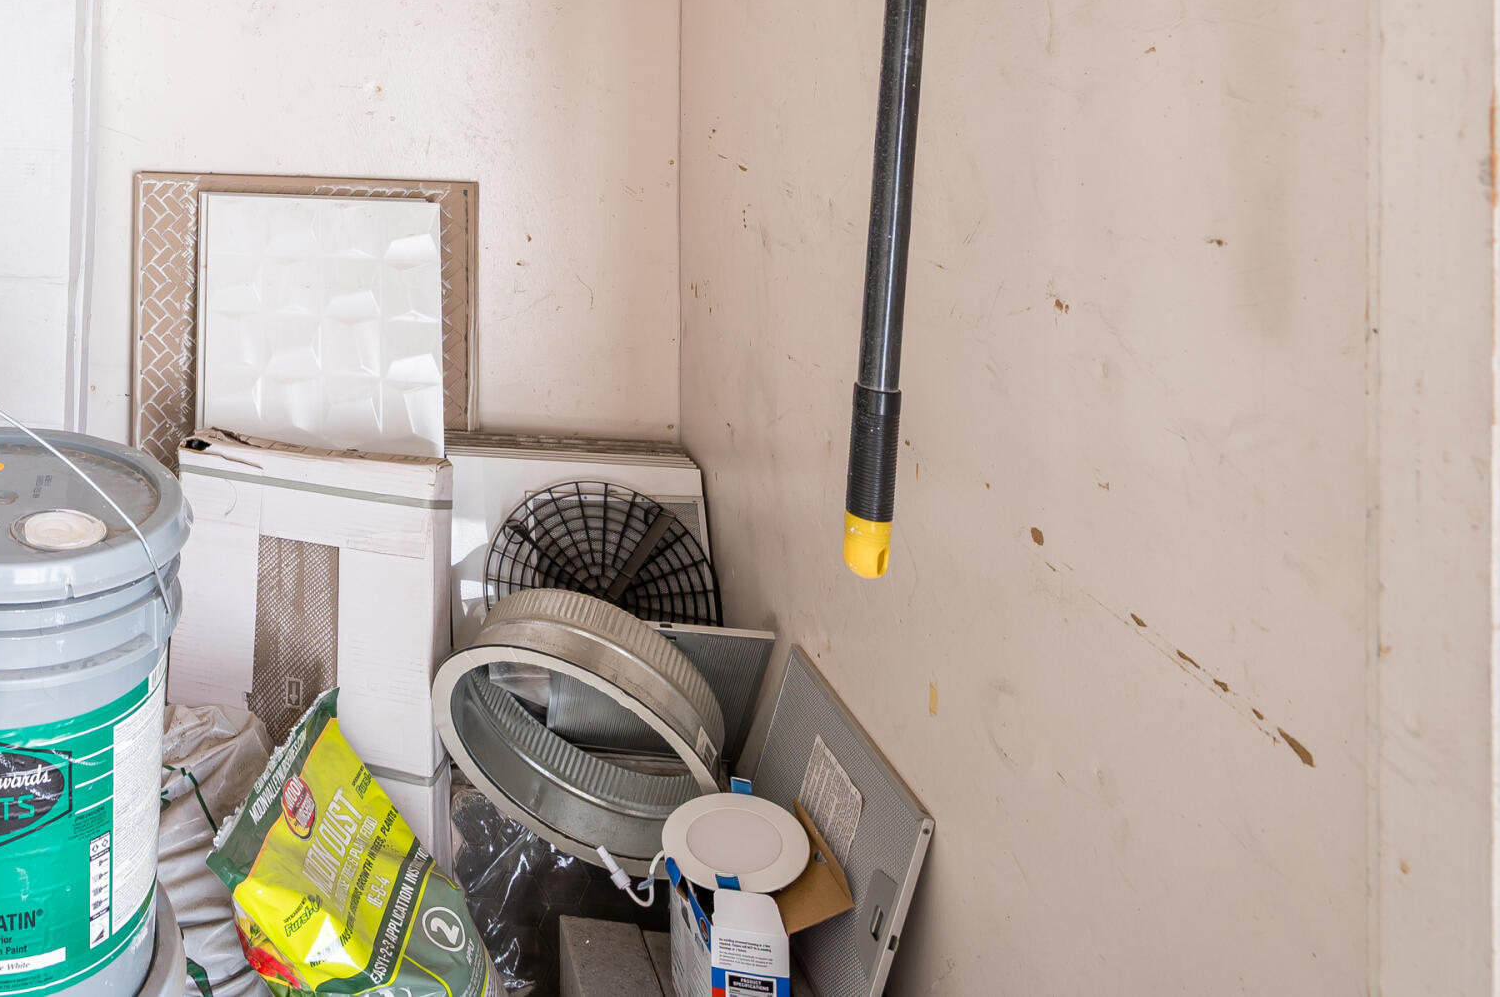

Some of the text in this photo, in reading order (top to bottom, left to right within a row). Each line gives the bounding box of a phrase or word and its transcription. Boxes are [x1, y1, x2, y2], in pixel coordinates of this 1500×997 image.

[284, 773, 304, 811] MOON
[318, 788, 362, 857] DUST
[349, 833, 365, 857] PLANT
[360, 815, 378, 837] FOOD
[302, 836, 341, 899] MOON
[357, 859, 373, 889] GROWTH
[380, 809, 397, 837] PLANTS
[366, 874, 391, 909] 16-8-4
[385, 882, 414, 943] APPLICATION
[430, 917, 459, 945] 2
[6, 945, 27, 955] Paint
[7, 962, 30, 970] White
